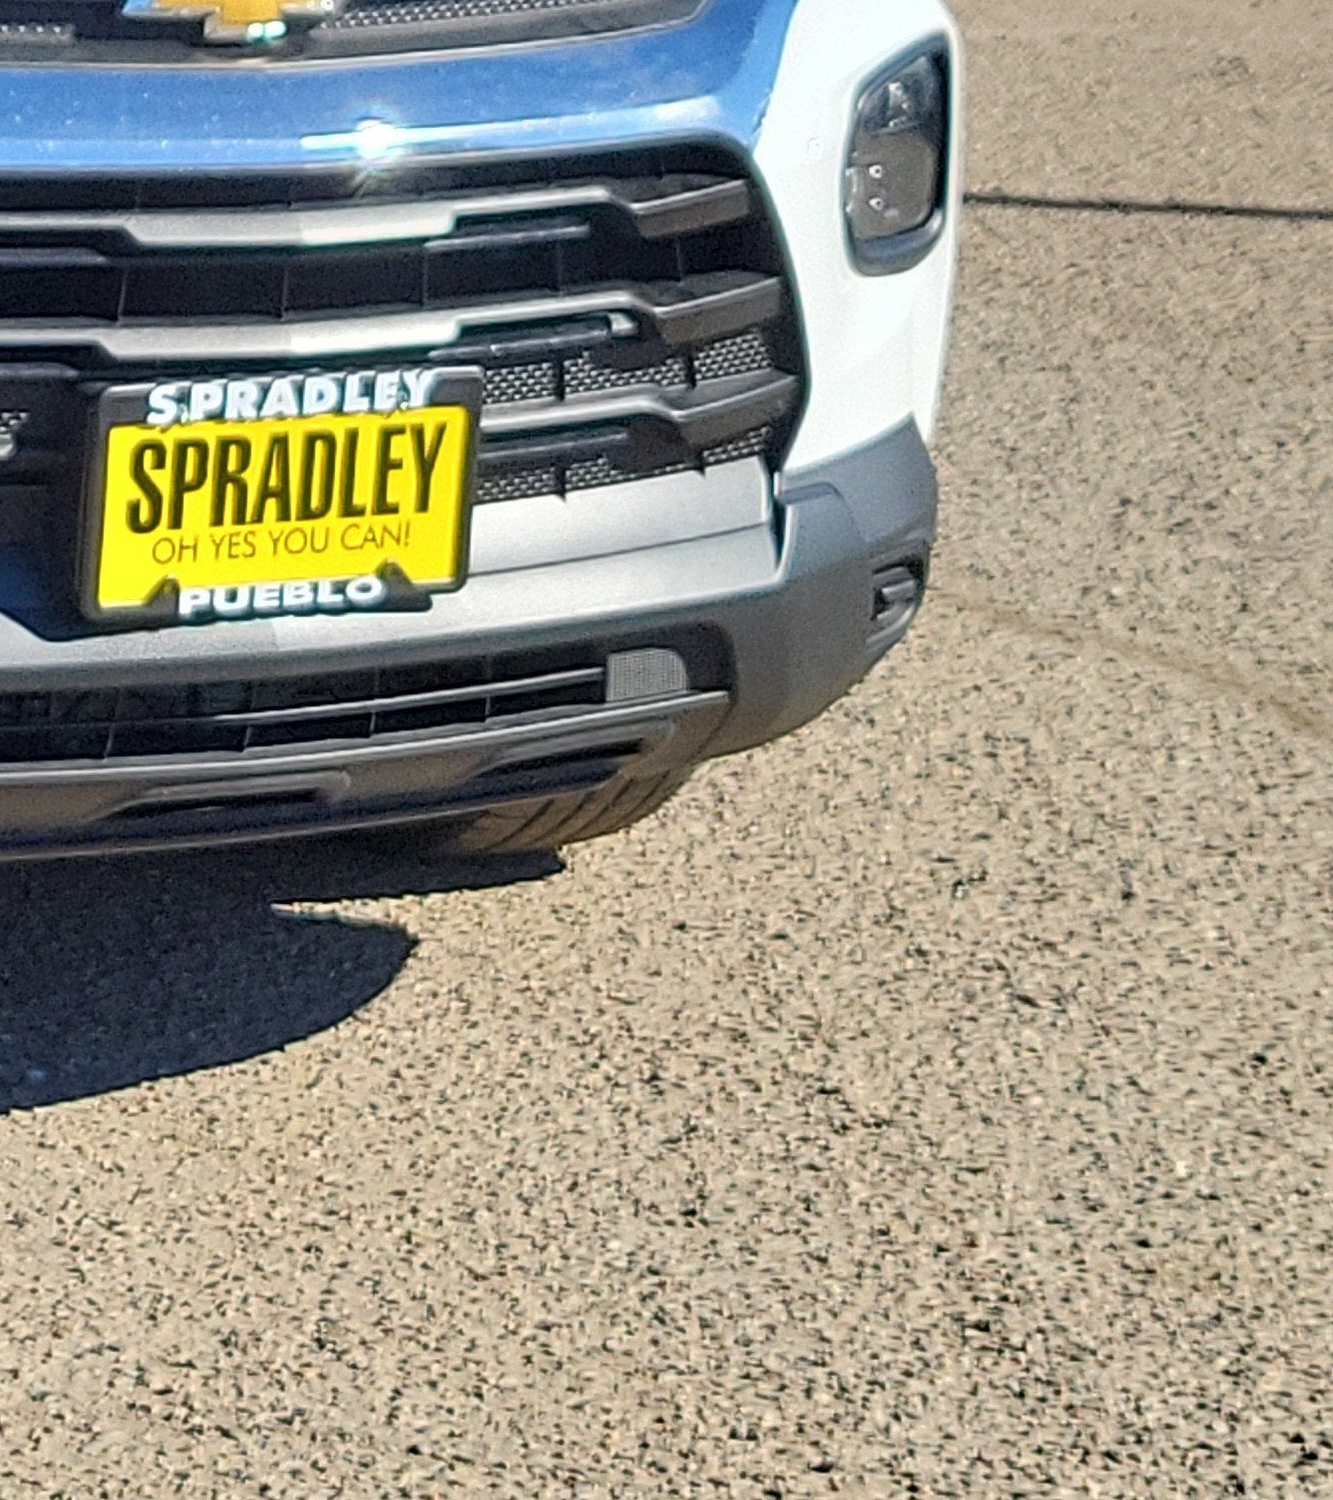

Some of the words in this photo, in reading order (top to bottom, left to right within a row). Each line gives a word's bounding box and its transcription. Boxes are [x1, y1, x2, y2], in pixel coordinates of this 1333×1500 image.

[146, 369, 434, 425] SPRADLEY
[126, 421, 447, 534] SPRADLEY
[151, 533, 197, 565] OH
[210, 531, 257, 560] YES
[270, 525, 330, 556] YOU
[340, 521, 411, 550] CAN!
[178, 574, 383, 619] PUEBLO
